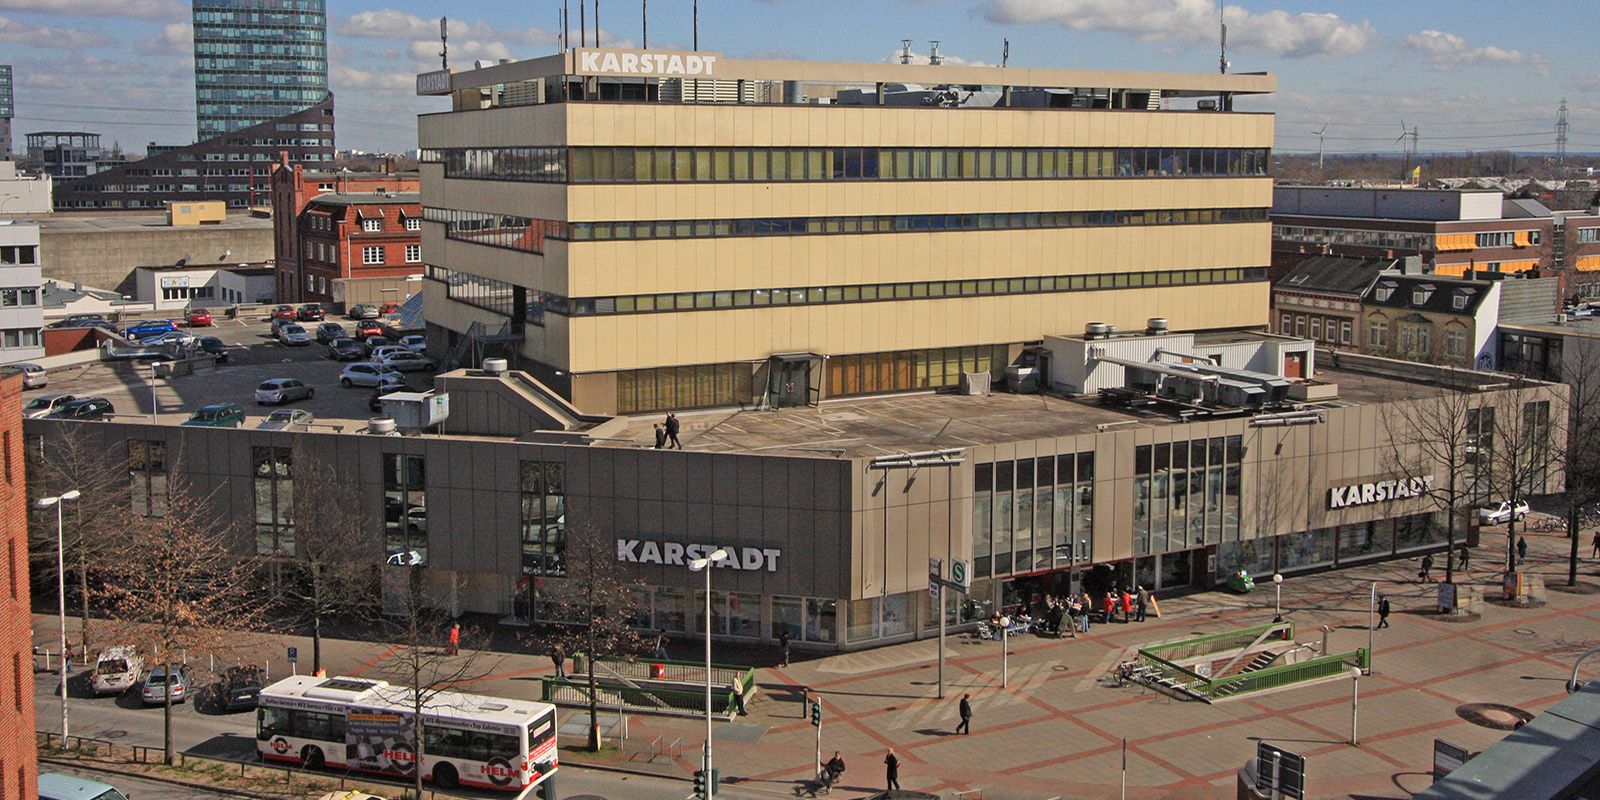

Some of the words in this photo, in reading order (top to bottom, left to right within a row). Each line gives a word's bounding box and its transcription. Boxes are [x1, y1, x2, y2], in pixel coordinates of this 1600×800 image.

[581, 51, 716, 75] KARSTADT
[418, 72, 449, 91] KARSTADT
[1329, 475, 1434, 508] KARSTADT
[617, 539, 781, 572] KARSTADT
[954, 563, 964, 582] S
[480, 765, 521, 778] HELM
